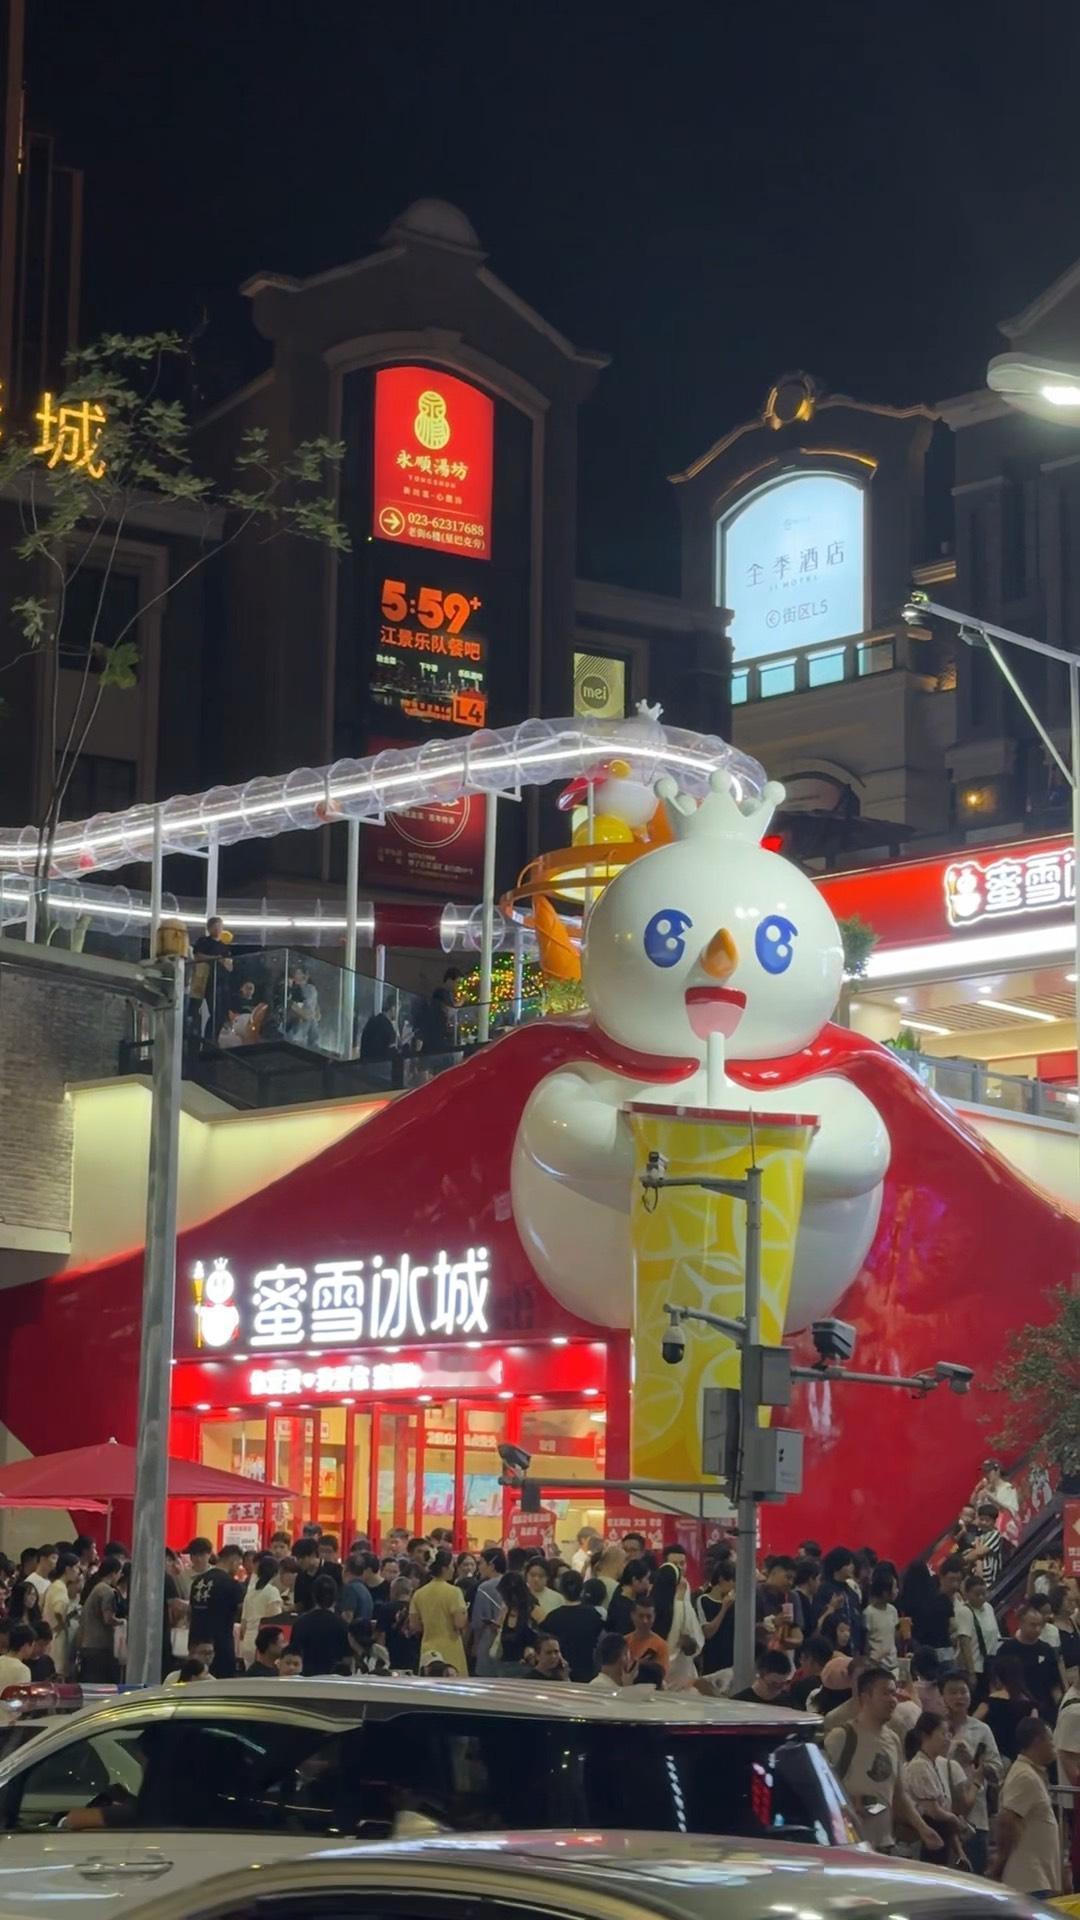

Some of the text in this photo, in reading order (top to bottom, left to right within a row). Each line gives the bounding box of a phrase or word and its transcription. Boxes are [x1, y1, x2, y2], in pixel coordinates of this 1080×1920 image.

[407, 512, 484, 536] 023-62317688
[745, 540, 846, 588] 全季酒店
[380, 624, 481, 661] 江景乐队餐吧
[583, 686, 606, 699] mei
[455, 700, 482, 723] L4
[249, 1246, 489, 1347] 蜜雪冰城
